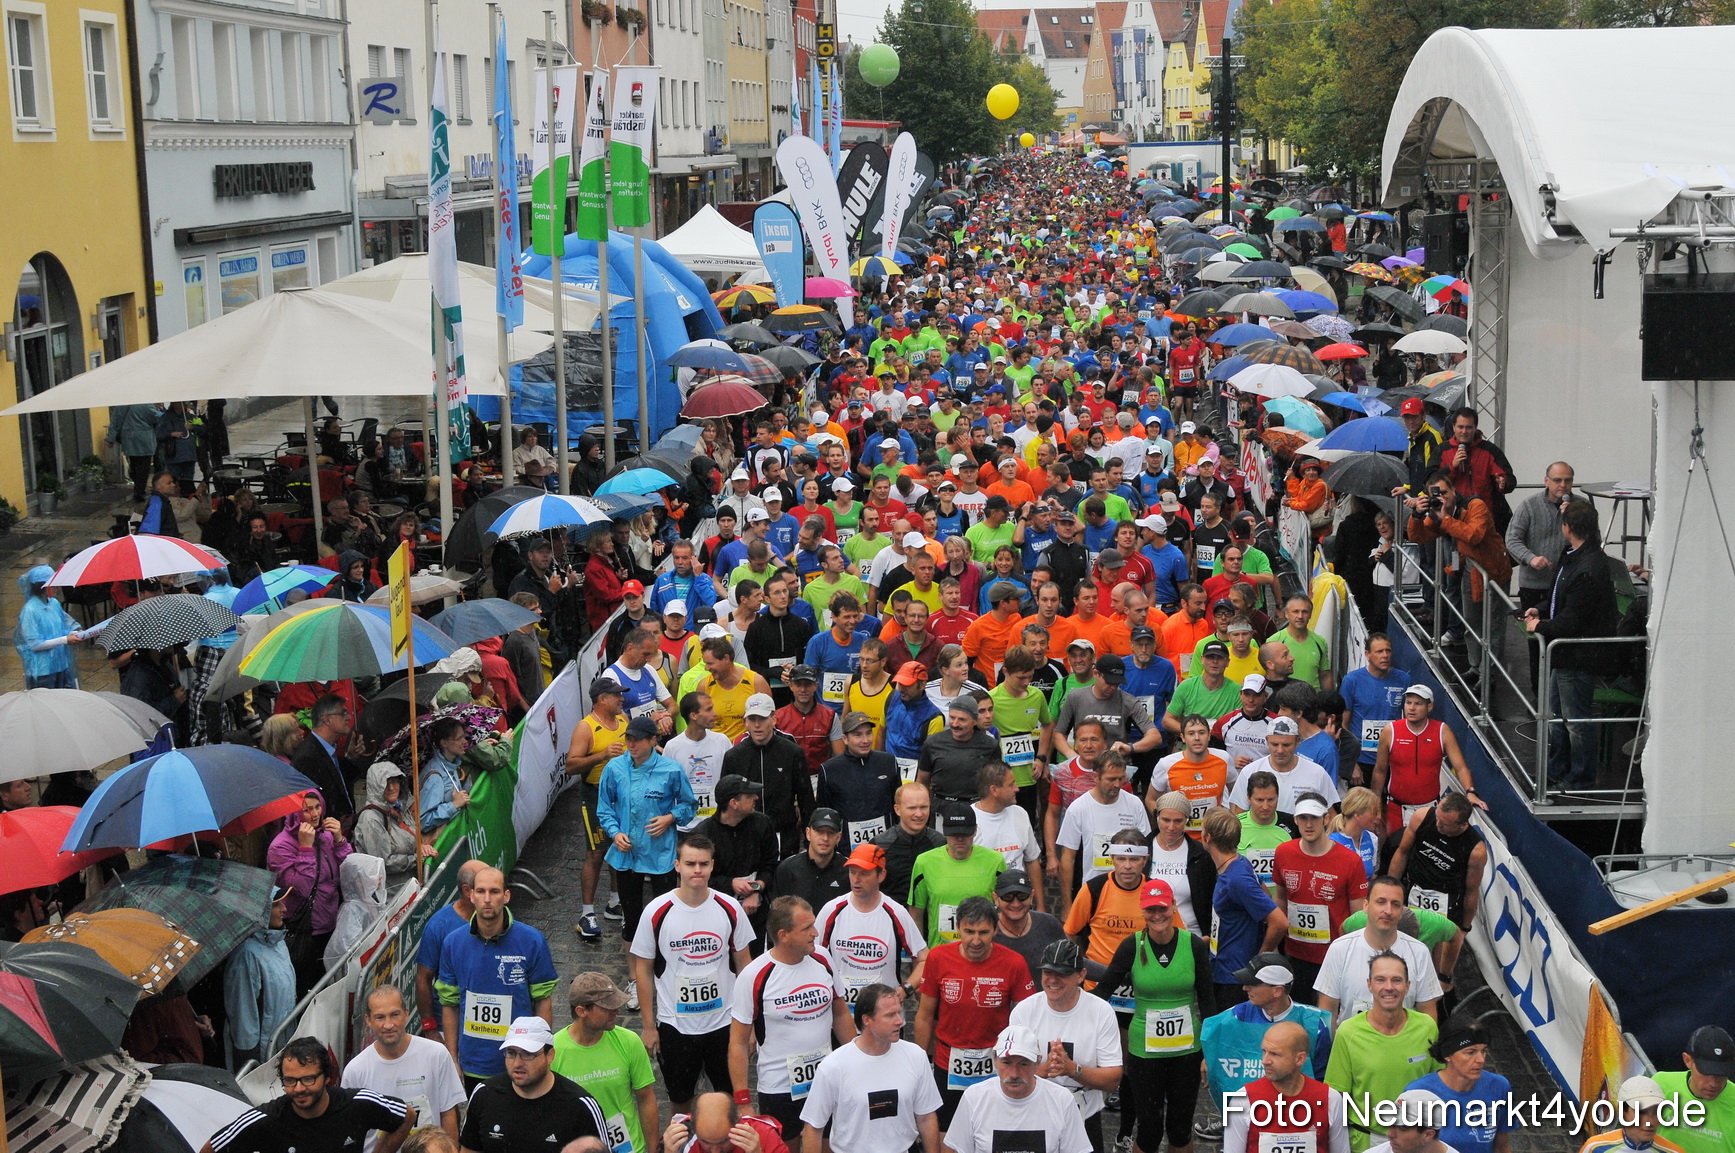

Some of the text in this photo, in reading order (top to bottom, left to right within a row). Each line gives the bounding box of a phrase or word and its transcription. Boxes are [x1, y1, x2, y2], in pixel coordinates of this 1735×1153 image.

[222, 161, 316, 197] BRILLEN WEBER
[842, 161, 882, 239] HULE
[1005, 739, 1031, 754] 2211
[1234, 734, 1266, 745] ERDINGER
[1179, 782, 1219, 791] SportScheck
[1416, 894, 1440, 912] 136
[1107, 920, 1137, 929] OEXL
[1297, 913, 1316, 929] 39
[1297, 930, 1318, 938] Markus
[669, 937, 712, 948] GERHART
[689, 944, 718, 953] JANIG
[835, 939, 878, 950] GERHART
[853, 949, 883, 958] JANIG
[680, 983, 719, 1002] 3166
[774, 989, 820, 1006] GERHART
[684, 1002, 716, 1012] Alexander
[798, 995, 829, 1009] JANIG
[472, 1004, 502, 1024] 189
[470, 1023, 500, 1035] Karlheinz
[1156, 1019, 1185, 1037] 807
[953, 1058, 994, 1076] 3349
